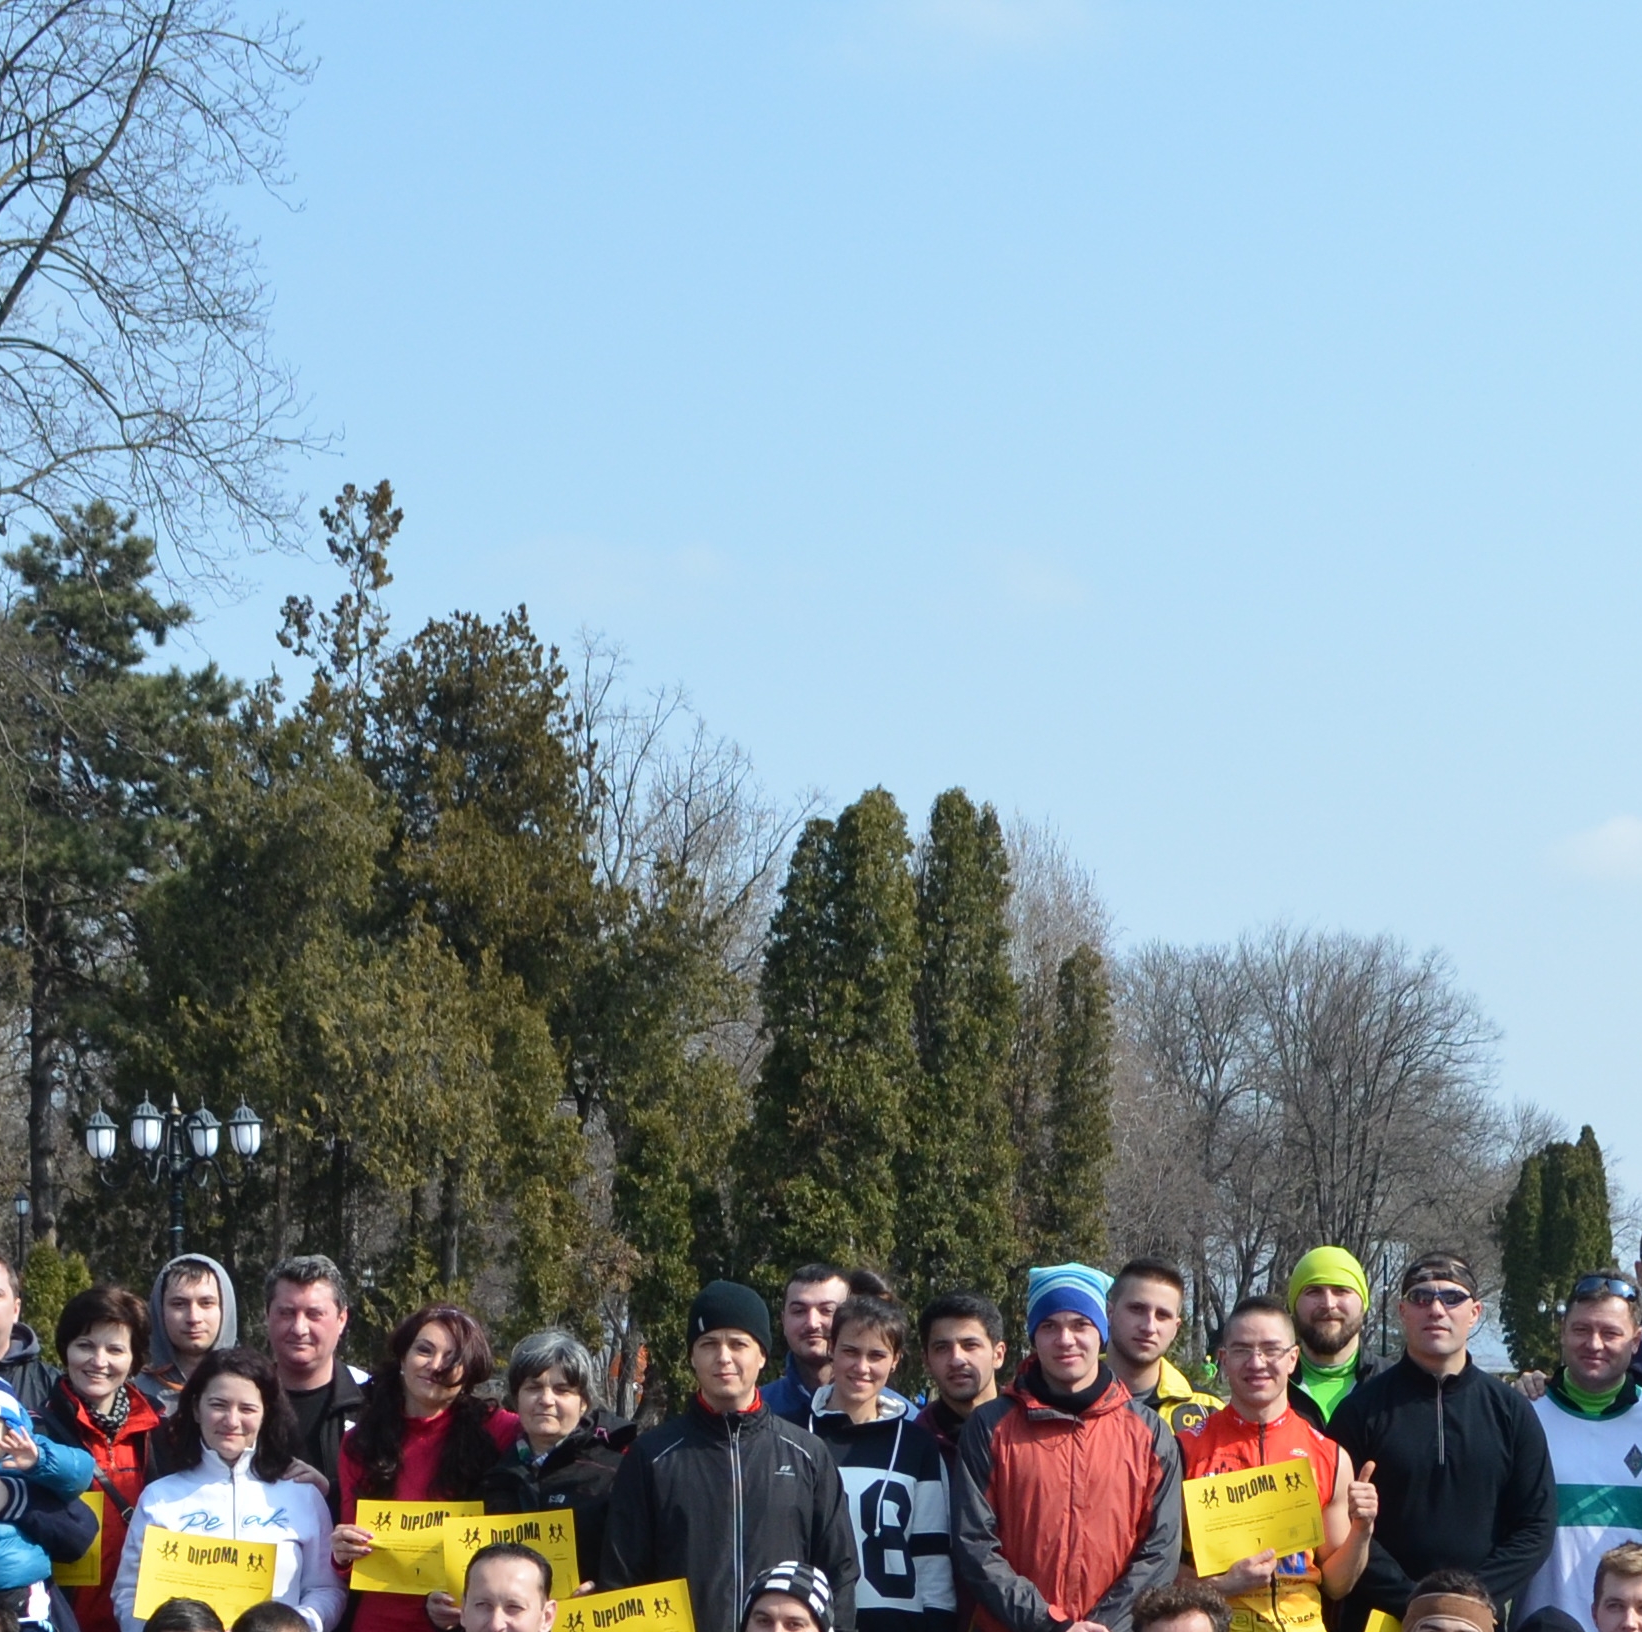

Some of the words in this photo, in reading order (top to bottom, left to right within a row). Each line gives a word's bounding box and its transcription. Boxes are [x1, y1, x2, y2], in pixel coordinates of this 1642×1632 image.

[1226, 1474, 1278, 1505] DIPLOMA
[490, 1521, 541, 1545] DIPLOMA
[860, 1479, 915, 1599] 8
[187, 1545, 239, 1567] DIPLOMA
[592, 1598, 646, 1629] DIPLOMA
